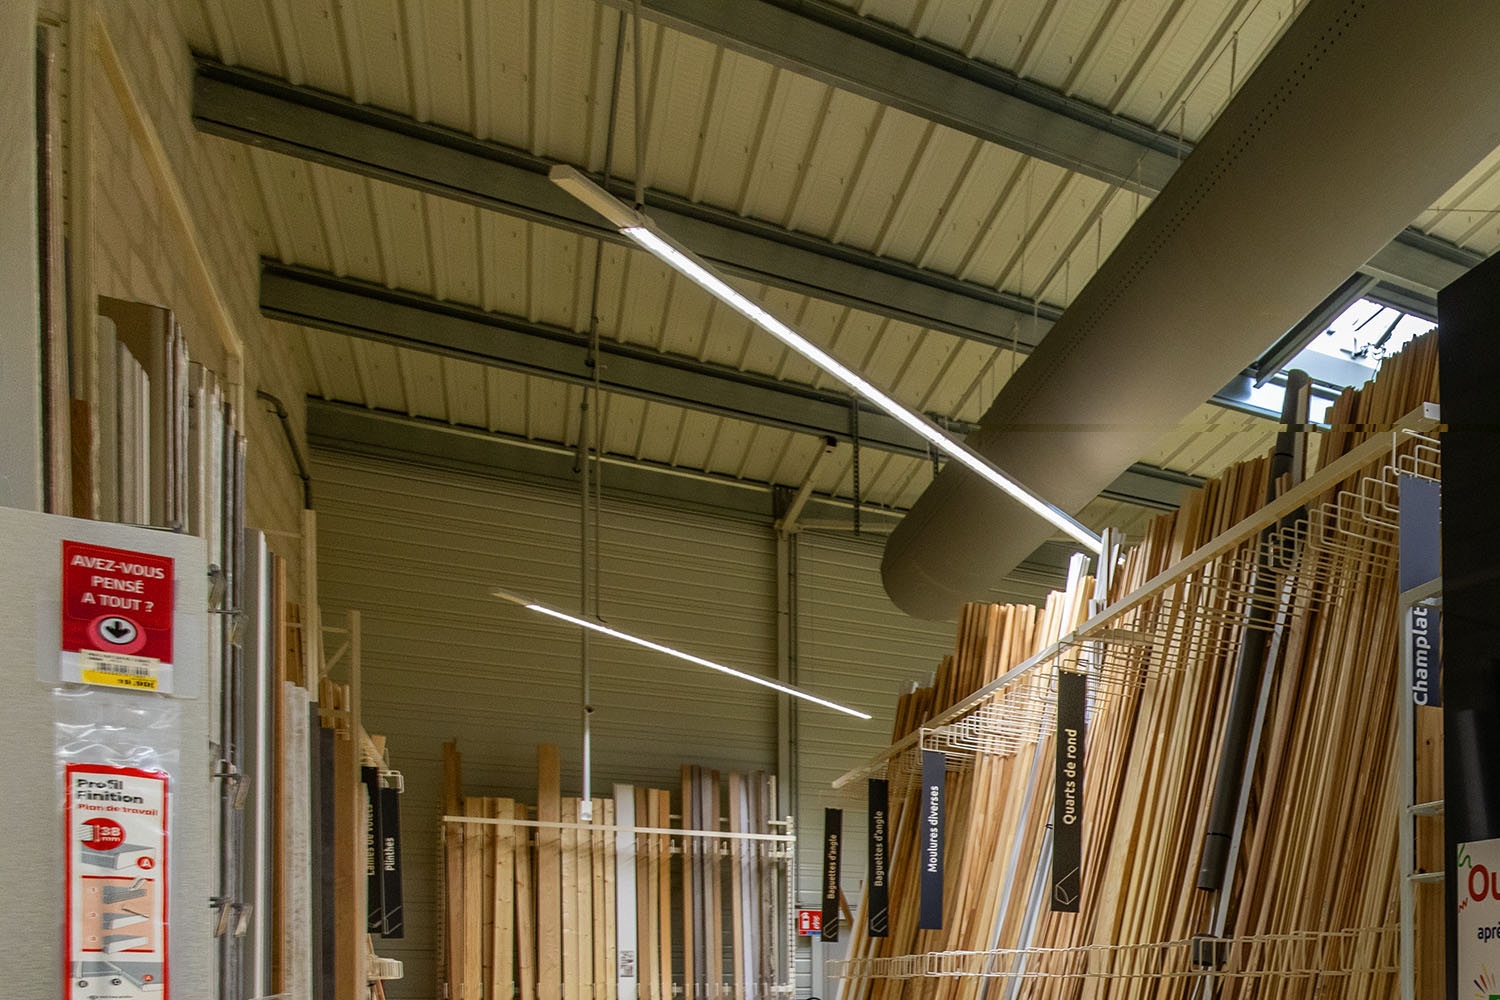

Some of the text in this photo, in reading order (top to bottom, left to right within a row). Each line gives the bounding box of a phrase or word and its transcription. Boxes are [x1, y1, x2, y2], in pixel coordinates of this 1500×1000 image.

[71, 554, 165, 580] AVEZ-VOUS
[91, 575, 145, 594] PENSÉ
[81, 592, 155, 613] A TOUT ?
[1412, 606, 1431, 706] Champlat
[77, 778, 123, 790] Profil
[1063, 728, 1078, 826] Quarts de rond
[77, 790, 144, 804] Finition
[78, 803, 104, 811] Plan
[122, 806, 158, 816] travail
[926, 785, 940, 873] Moulures diverses
[384, 837, 395, 871] Plinthes
[874, 810, 885, 887] Baguettes d'angle
[827, 833, 838, 900] Baguettes d'angle
